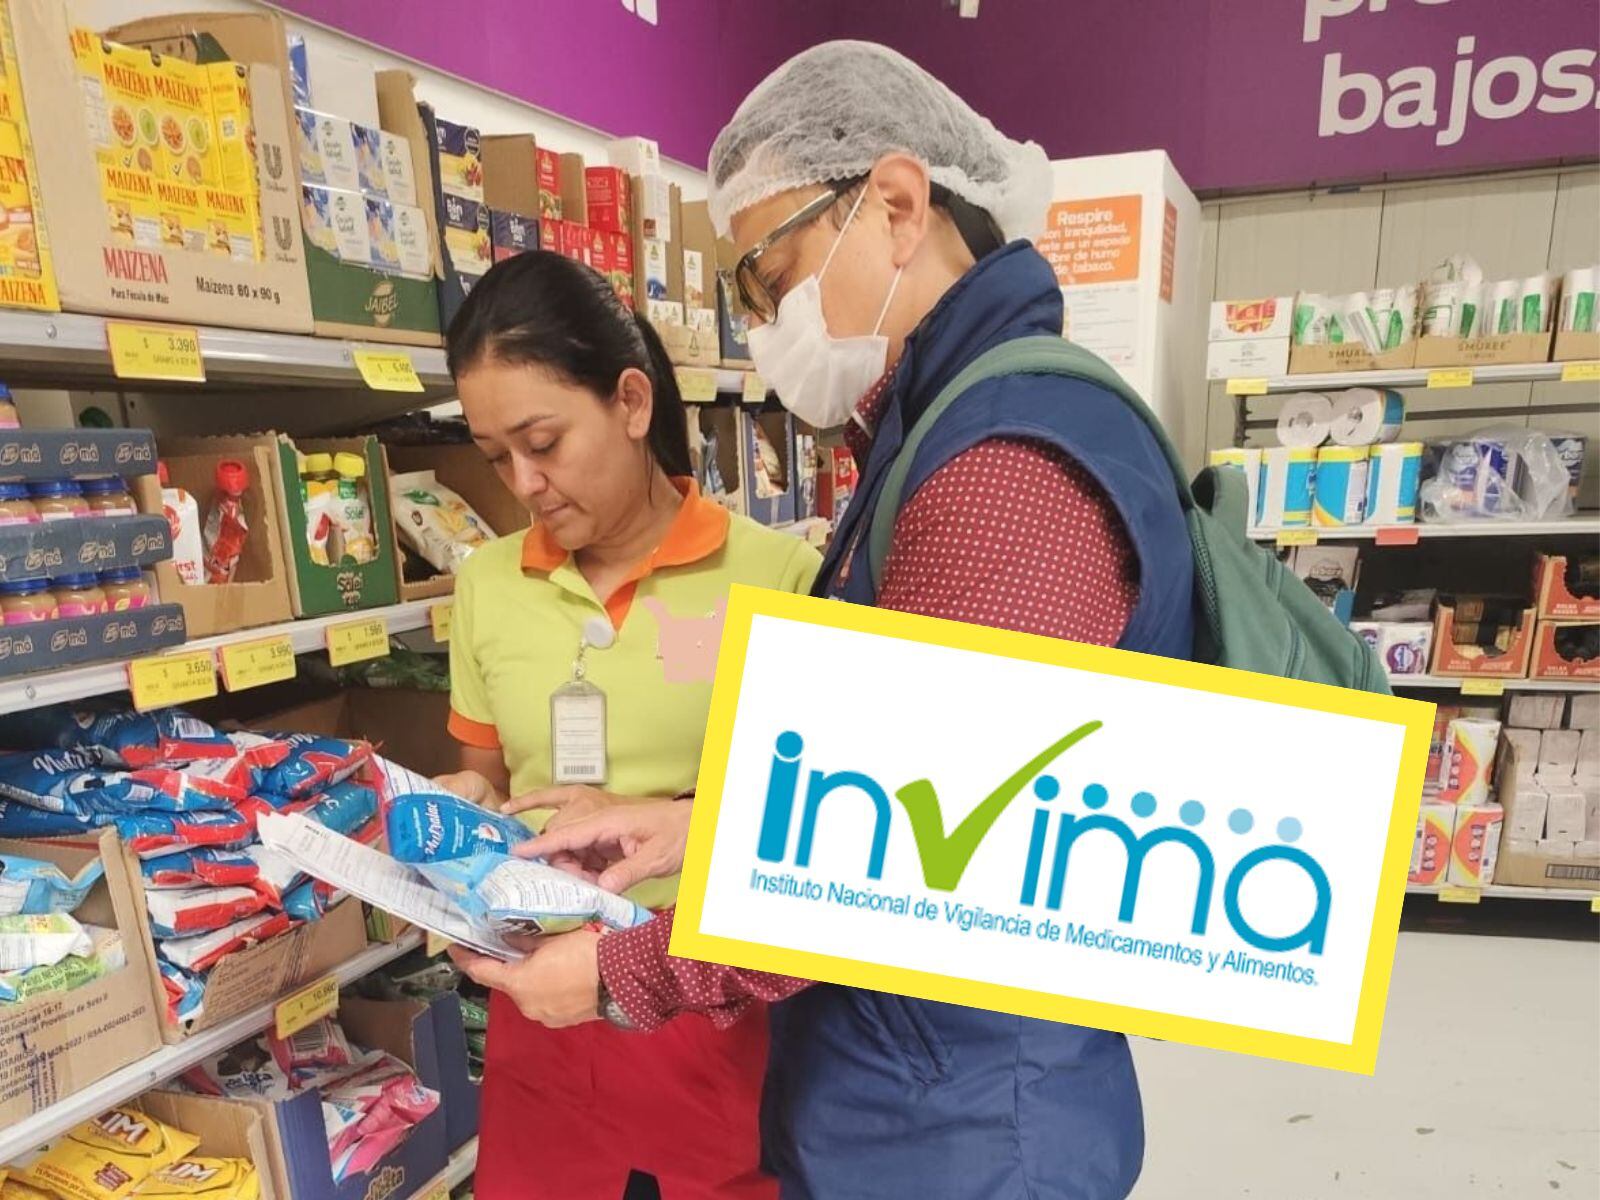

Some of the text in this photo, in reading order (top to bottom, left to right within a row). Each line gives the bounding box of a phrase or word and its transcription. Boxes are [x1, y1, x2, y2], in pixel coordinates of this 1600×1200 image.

[103, 63, 153, 98] MAIZENA
[106, 169, 153, 196] MAIZENA
[157, 183, 200, 208] MAIZENA
[206, 190, 247, 214] MAIZENA
[1057, 208, 1114, 227] Respire
[102, 247, 169, 284] MAIZENA
[0, 279, 47, 306] AIZENA
[196, 275, 234, 296] Maizena
[364, 293, 400, 312] JAIBEL
[185, 659, 213, 675] 3.650
